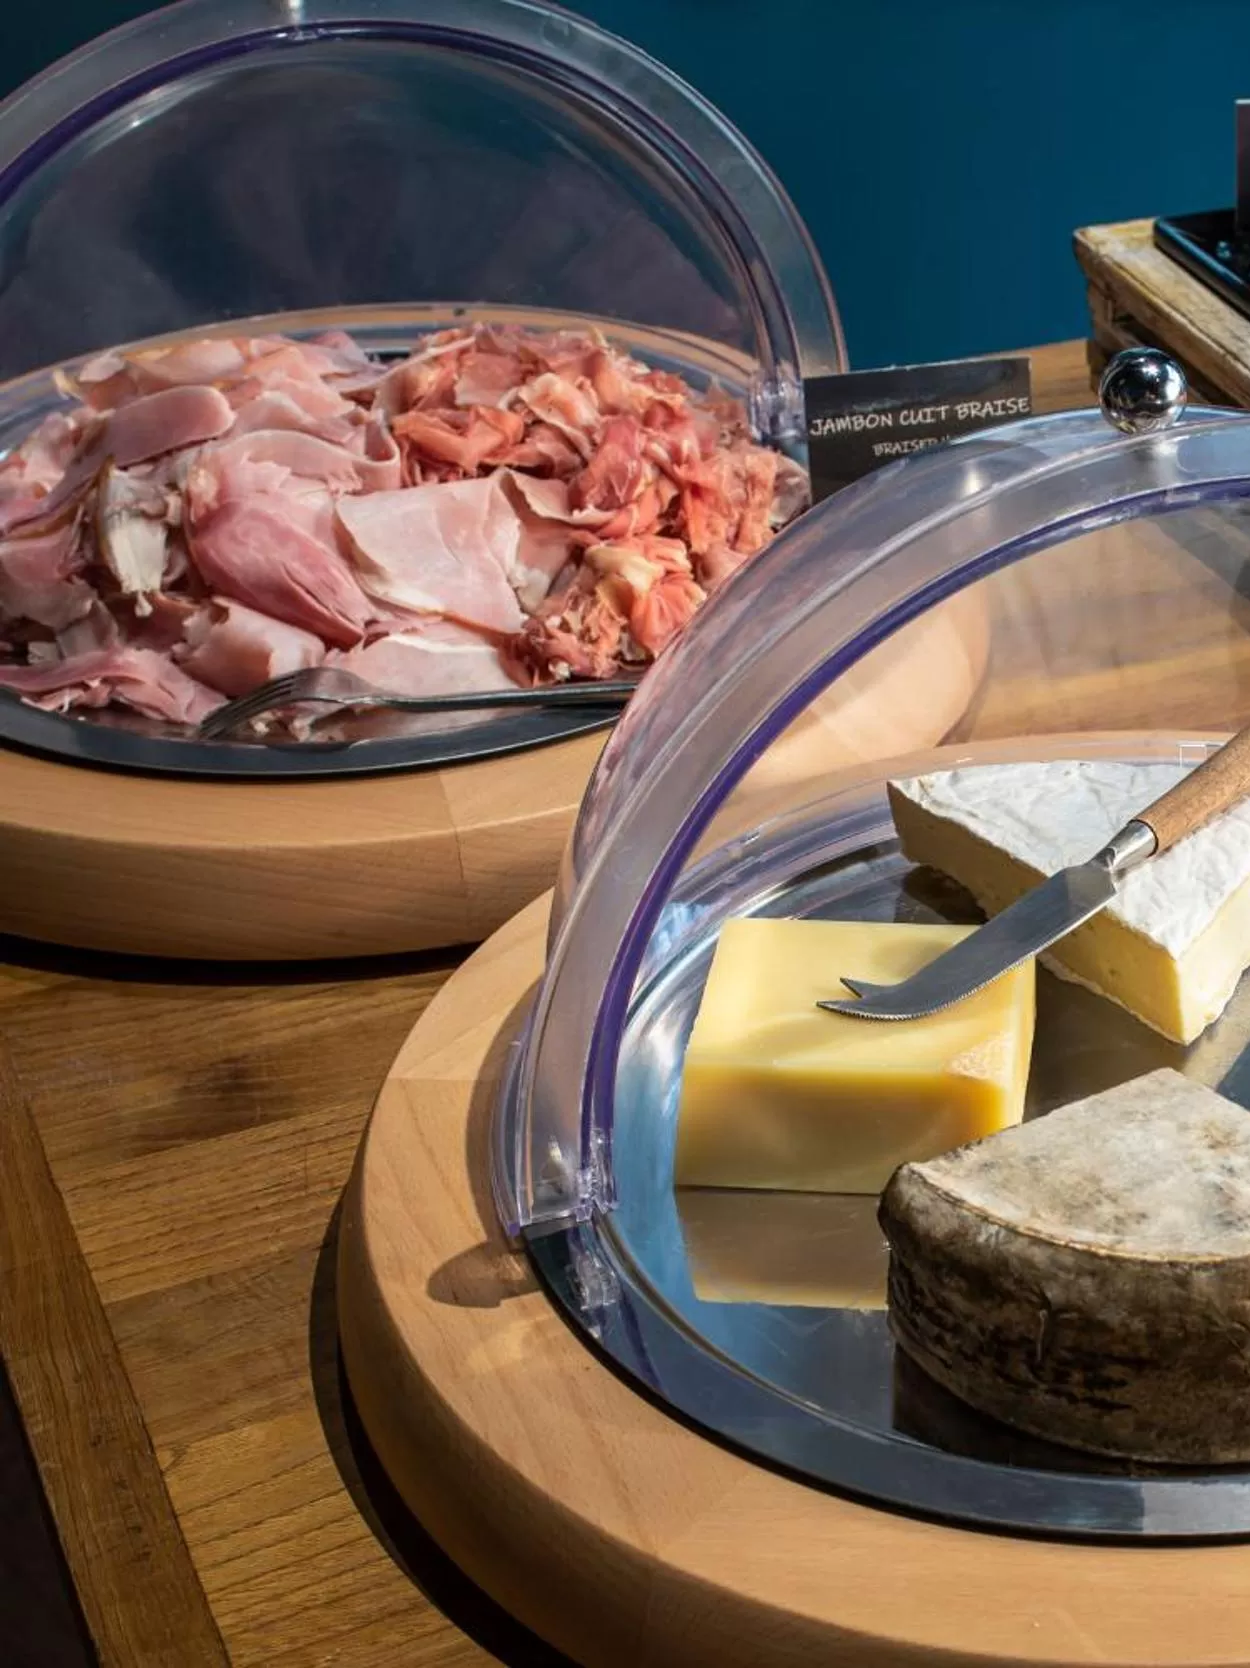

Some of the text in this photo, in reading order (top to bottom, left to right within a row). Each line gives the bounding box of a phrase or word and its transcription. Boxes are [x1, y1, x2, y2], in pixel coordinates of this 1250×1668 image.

[810, 397, 1031, 436] JAMBON CUIT BRAISE
